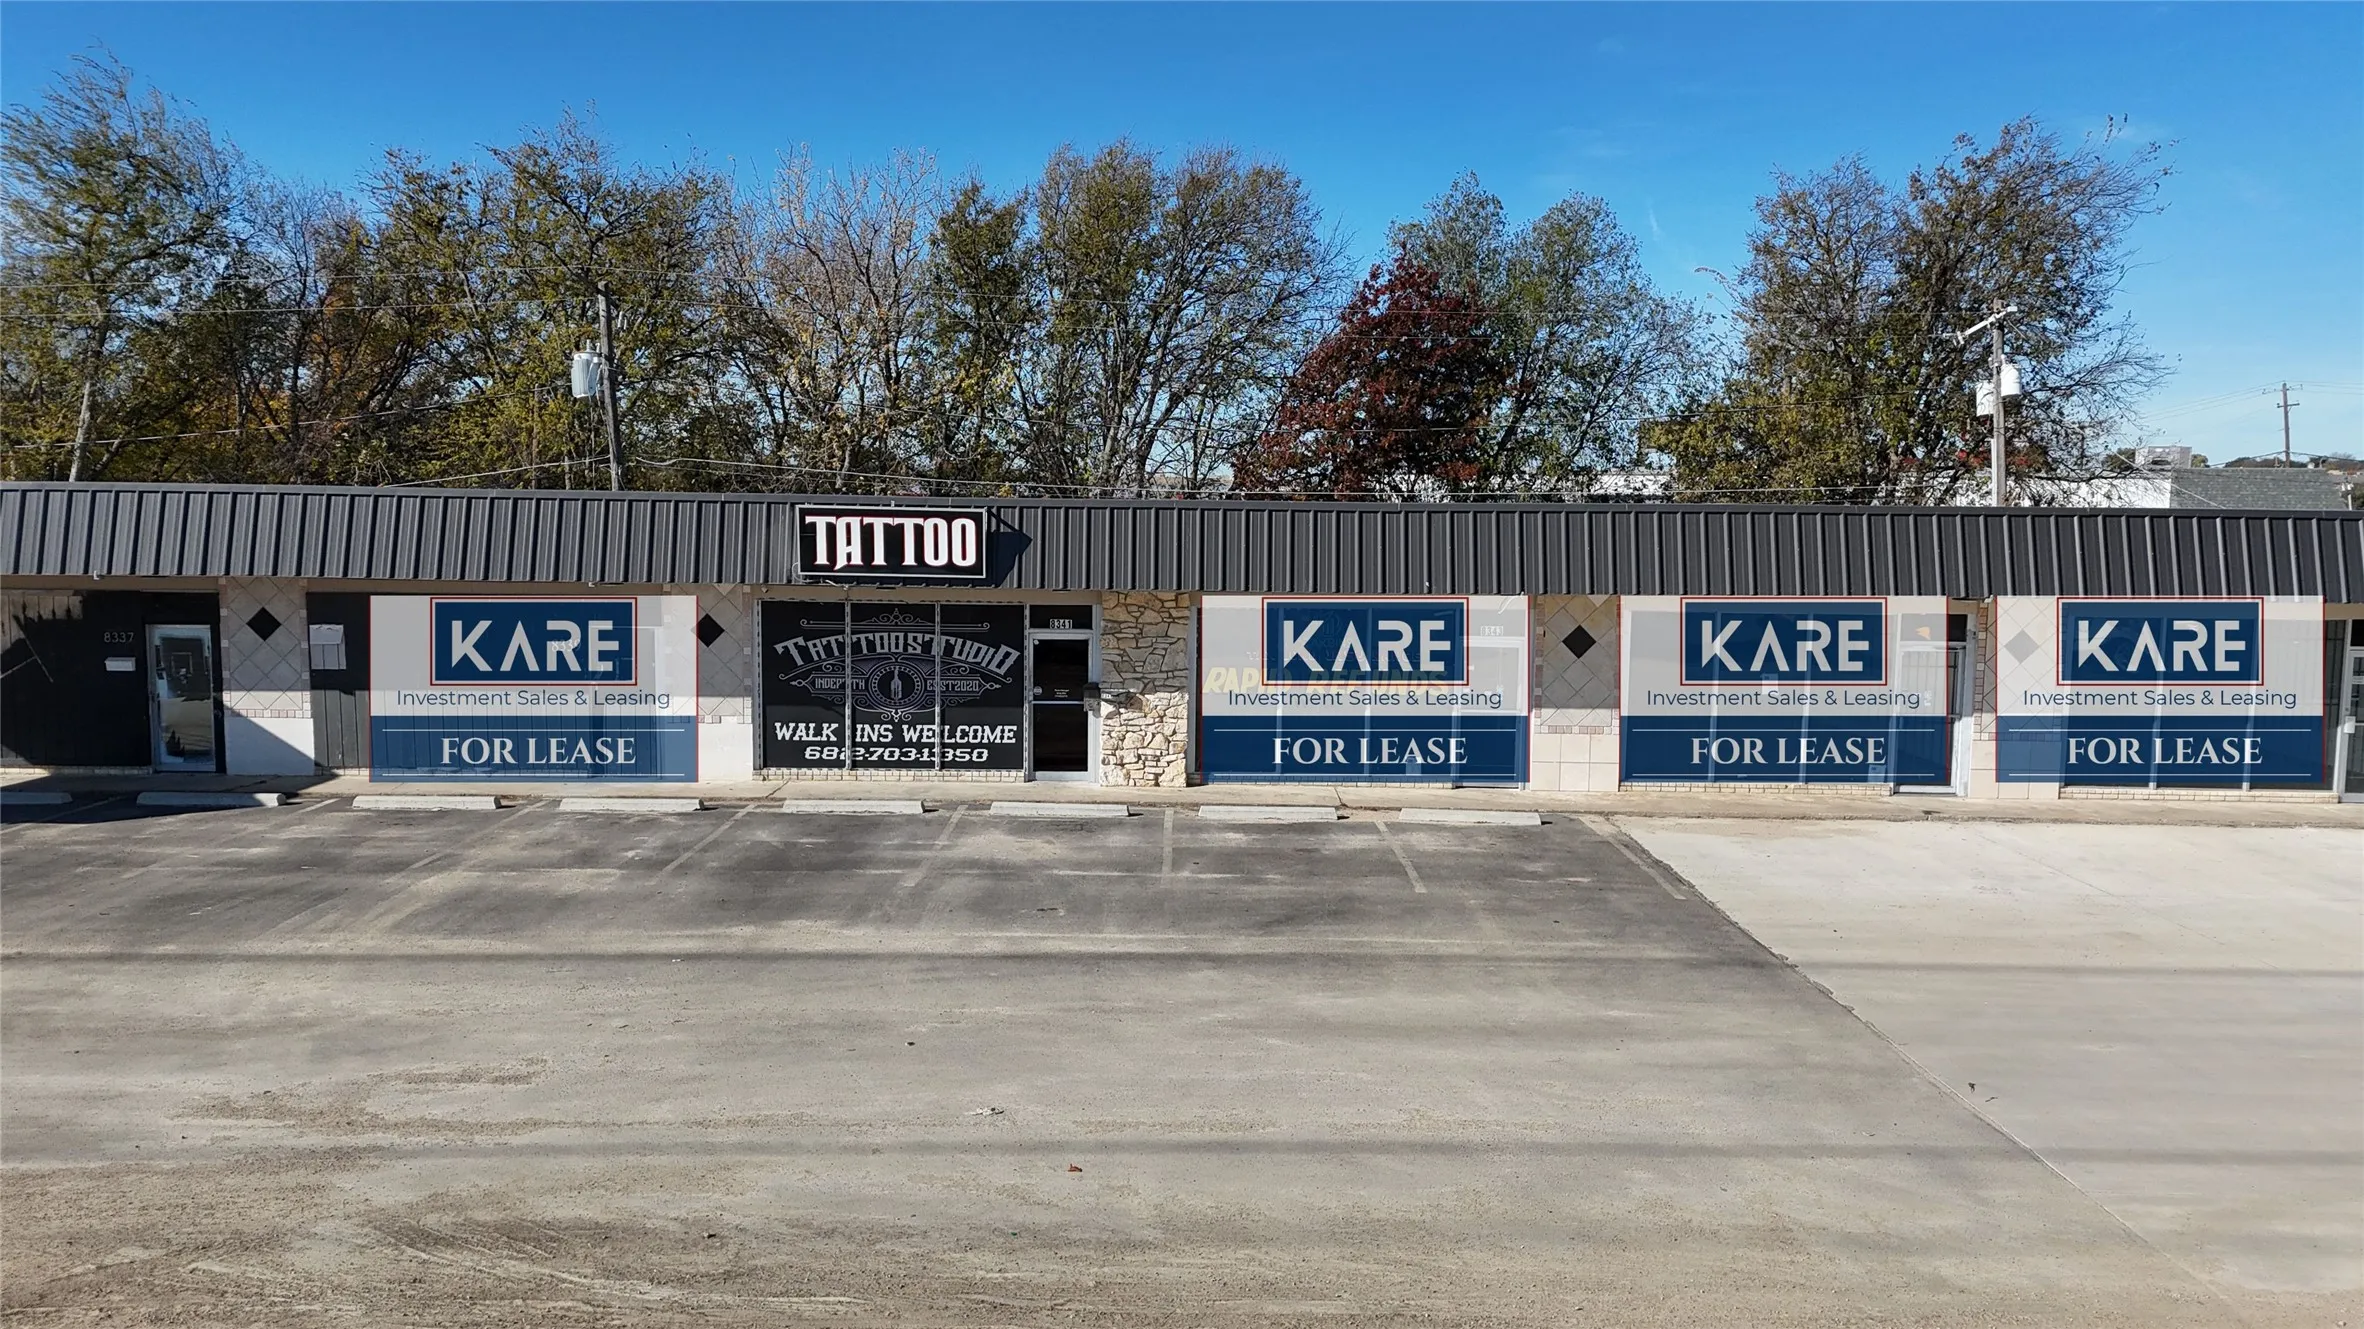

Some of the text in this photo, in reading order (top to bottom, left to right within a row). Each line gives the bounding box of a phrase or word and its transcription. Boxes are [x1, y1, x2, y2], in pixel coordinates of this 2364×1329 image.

[805, 515, 977, 571] TATTOO
[1050, 619, 1072, 629] 8341
[103, 631, 134, 643] 8337
[774, 722, 1017, 743] WALK INS WELCOME
